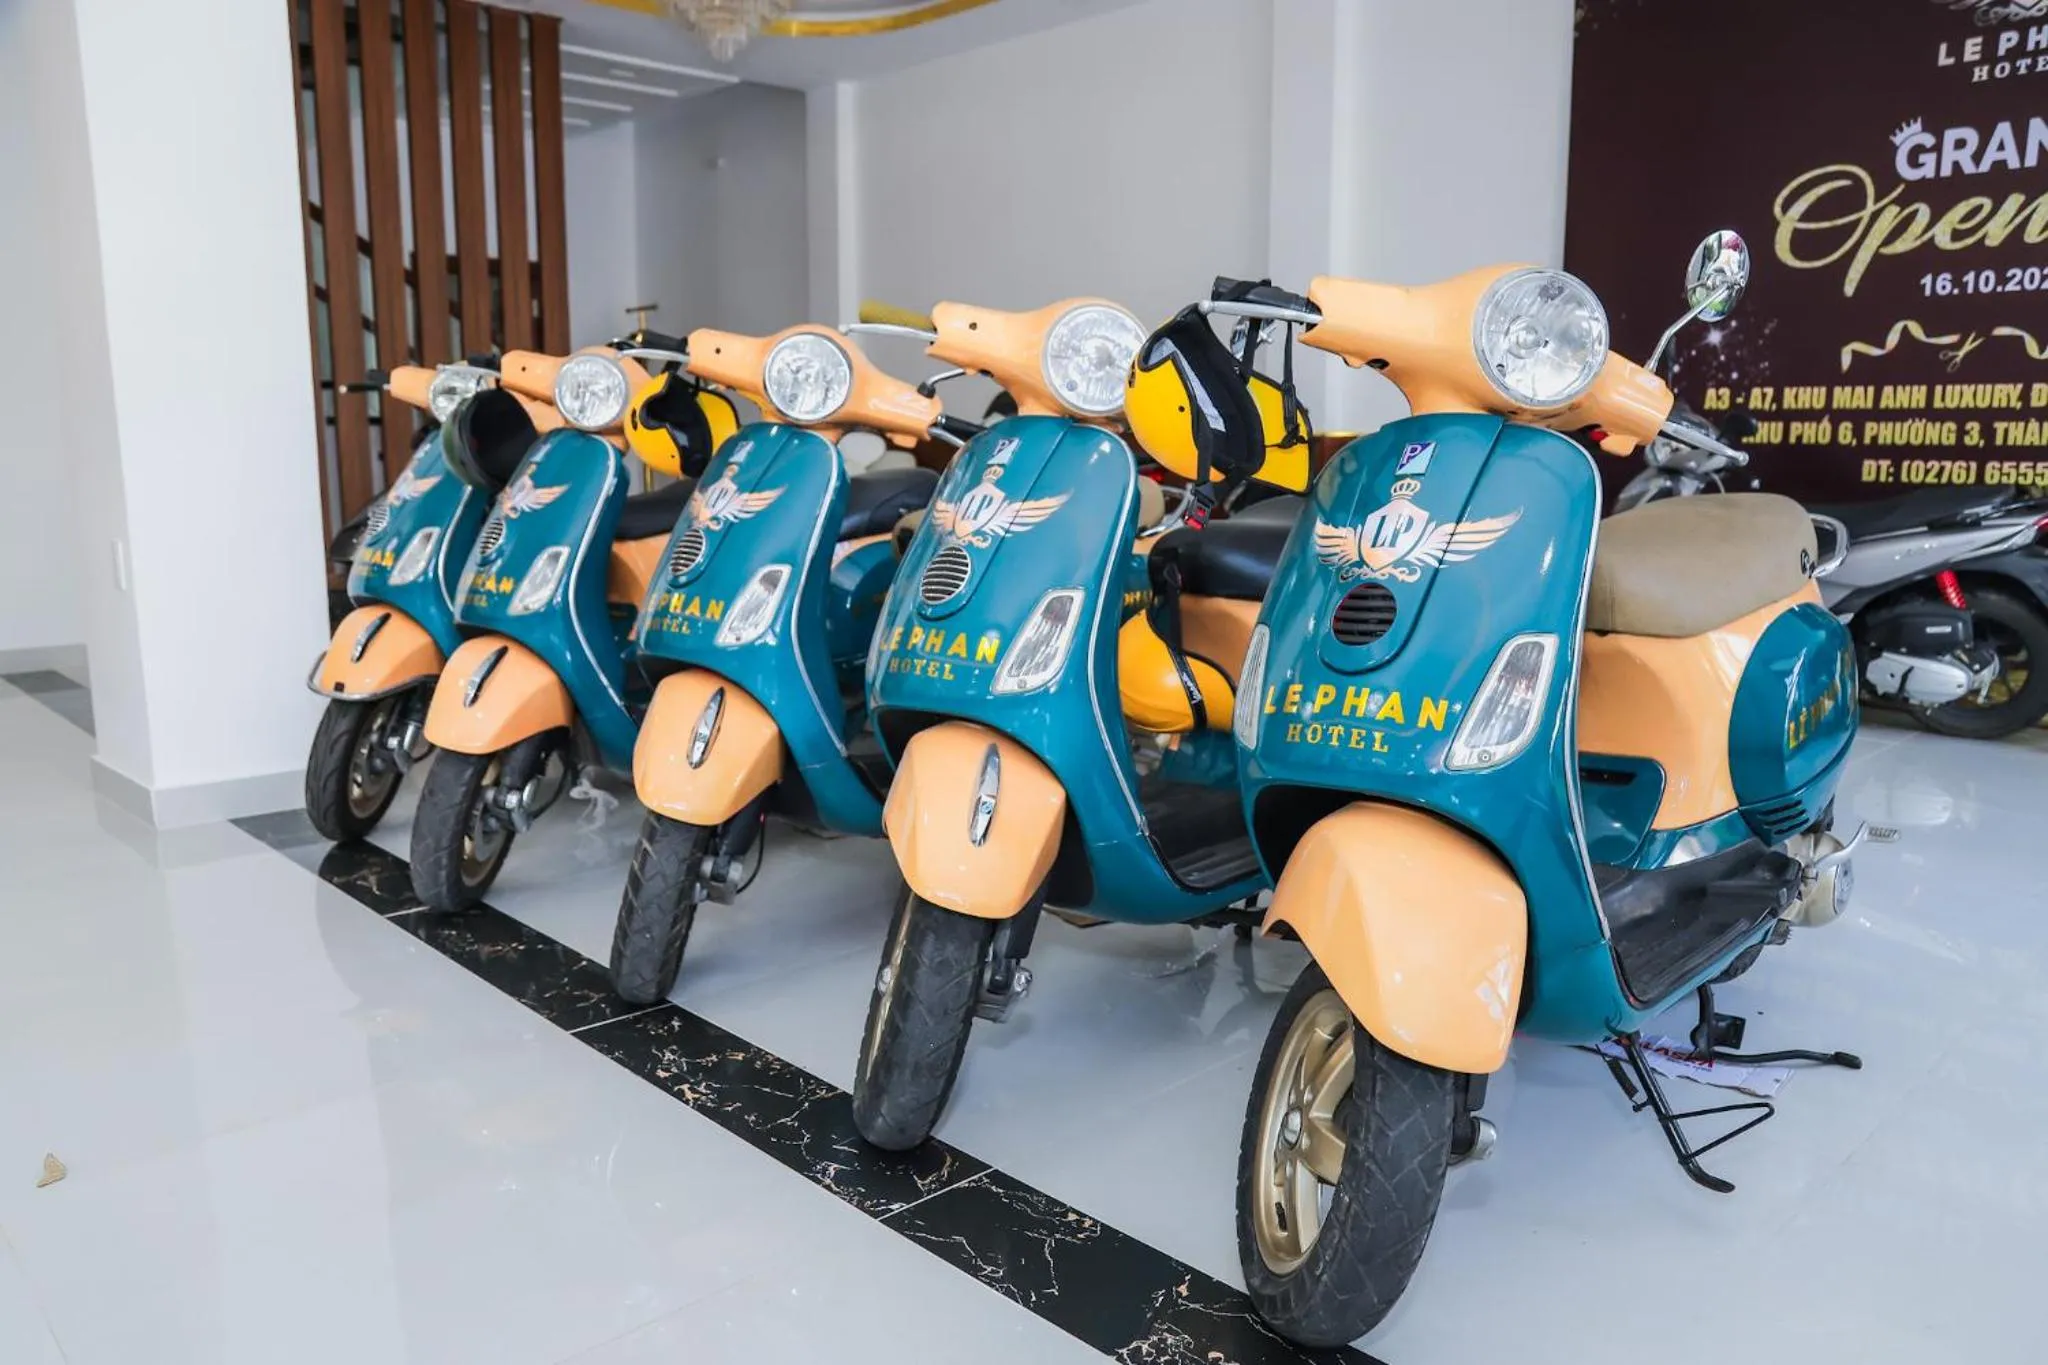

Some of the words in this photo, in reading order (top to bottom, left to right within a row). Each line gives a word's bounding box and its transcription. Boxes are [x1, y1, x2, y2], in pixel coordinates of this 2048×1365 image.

[1938, 36, 1983, 67] LE
[1971, 55, 2048, 83] HOTE
[1704, 386, 1731, 410] A3
[1748, 385, 1777, 411] A7,
[1782, 385, 1827, 410] KHU
[1832, 385, 1875, 410] MAI
[1880, 384, 1928, 409] ANH
[1933, 383, 2023, 411] LUXURY,
[1742, 421, 1785, 444] HU
[1837, 421, 1857, 447] 6,
[1964, 421, 1985, 448] 3,
[1900, 459, 1978, 484] (0276)
[889, 656, 956, 681] HOTEL
[1286, 723, 1390, 753] HOTEL
